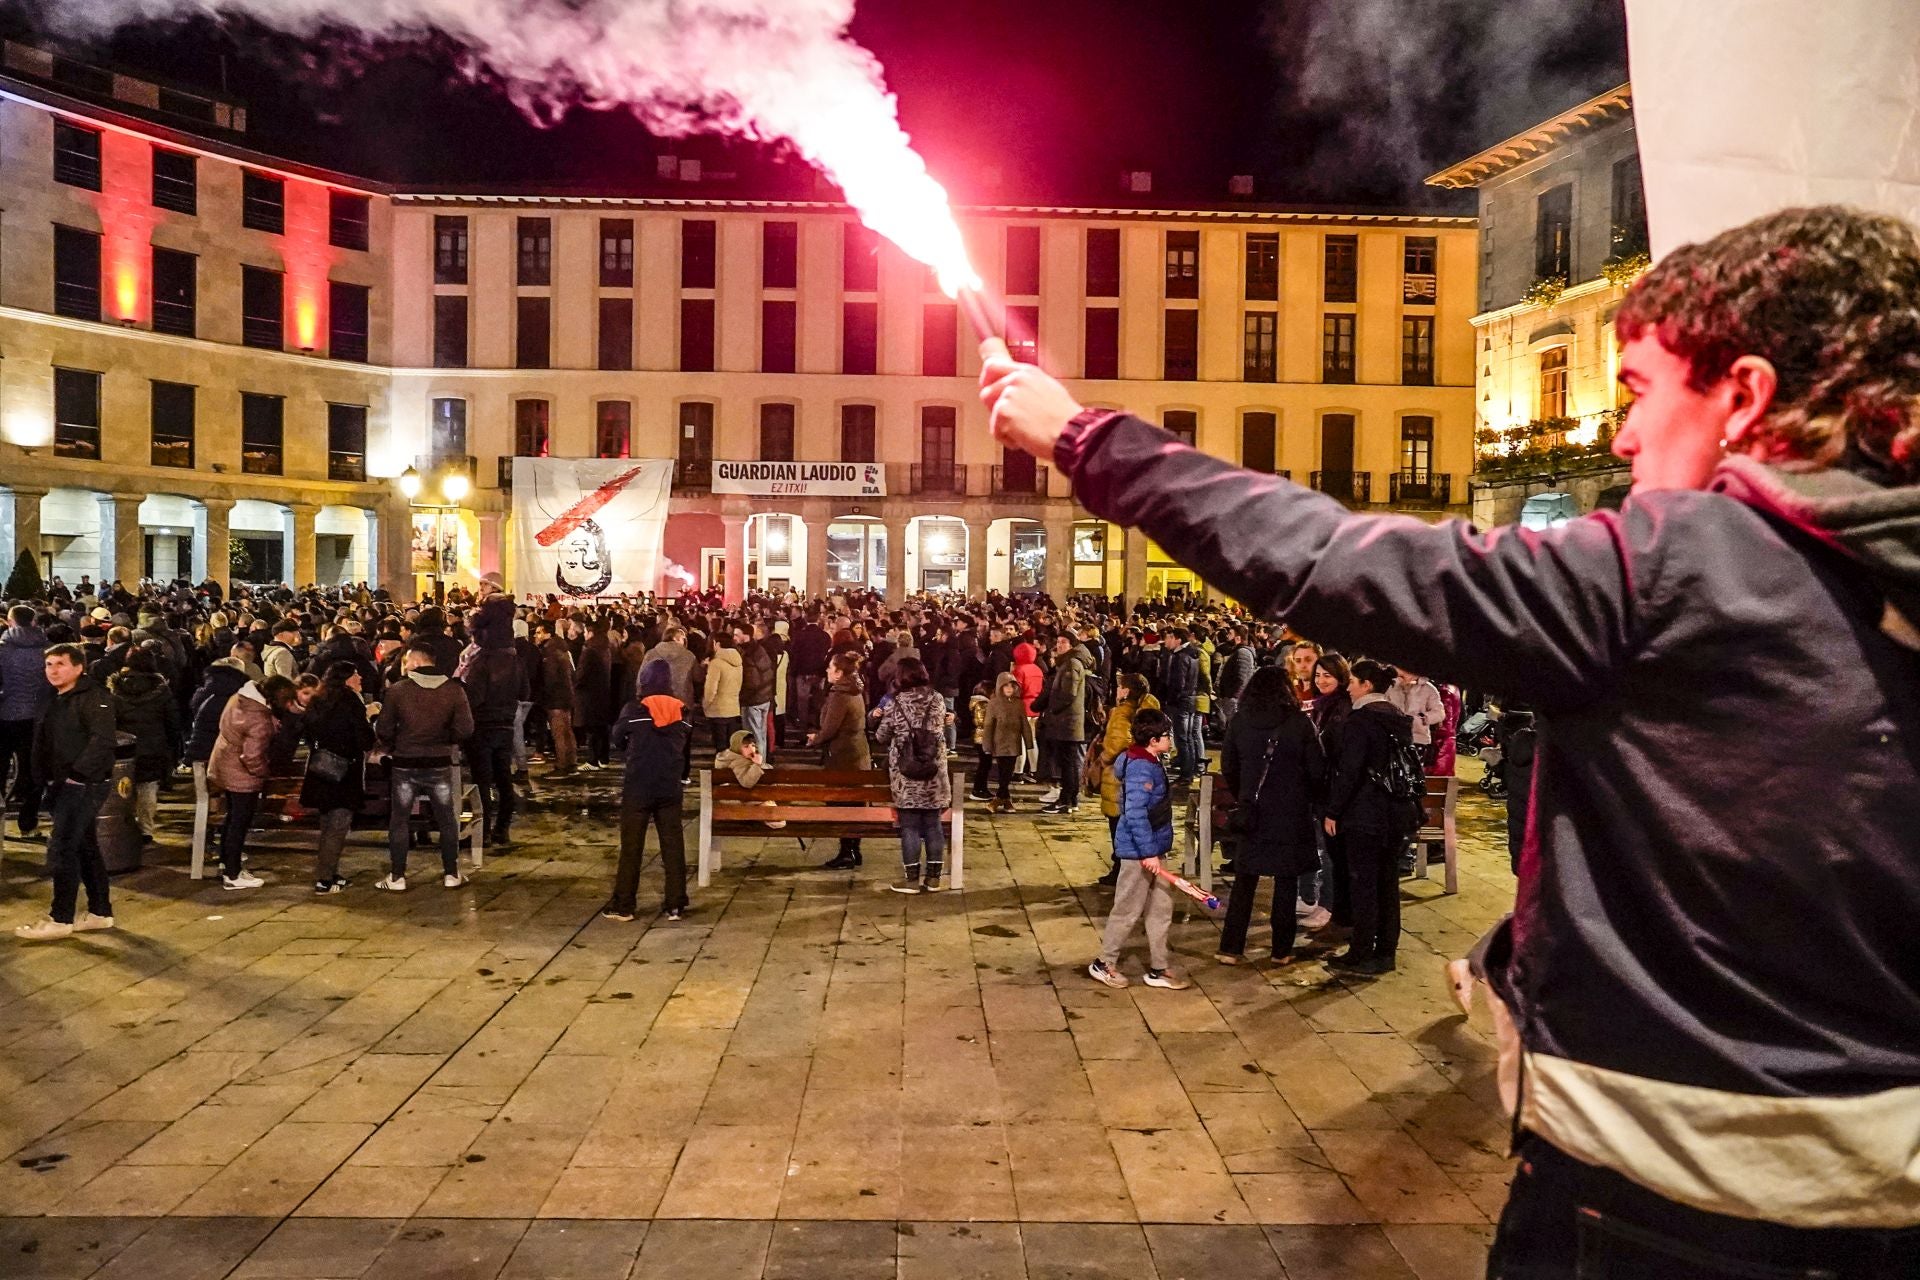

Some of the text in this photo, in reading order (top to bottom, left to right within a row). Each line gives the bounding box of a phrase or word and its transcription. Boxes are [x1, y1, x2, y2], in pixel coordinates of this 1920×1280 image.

[718, 463, 857, 482] GUARDIAN LAUDIO
[771, 482, 808, 494] EZ ITXI!
